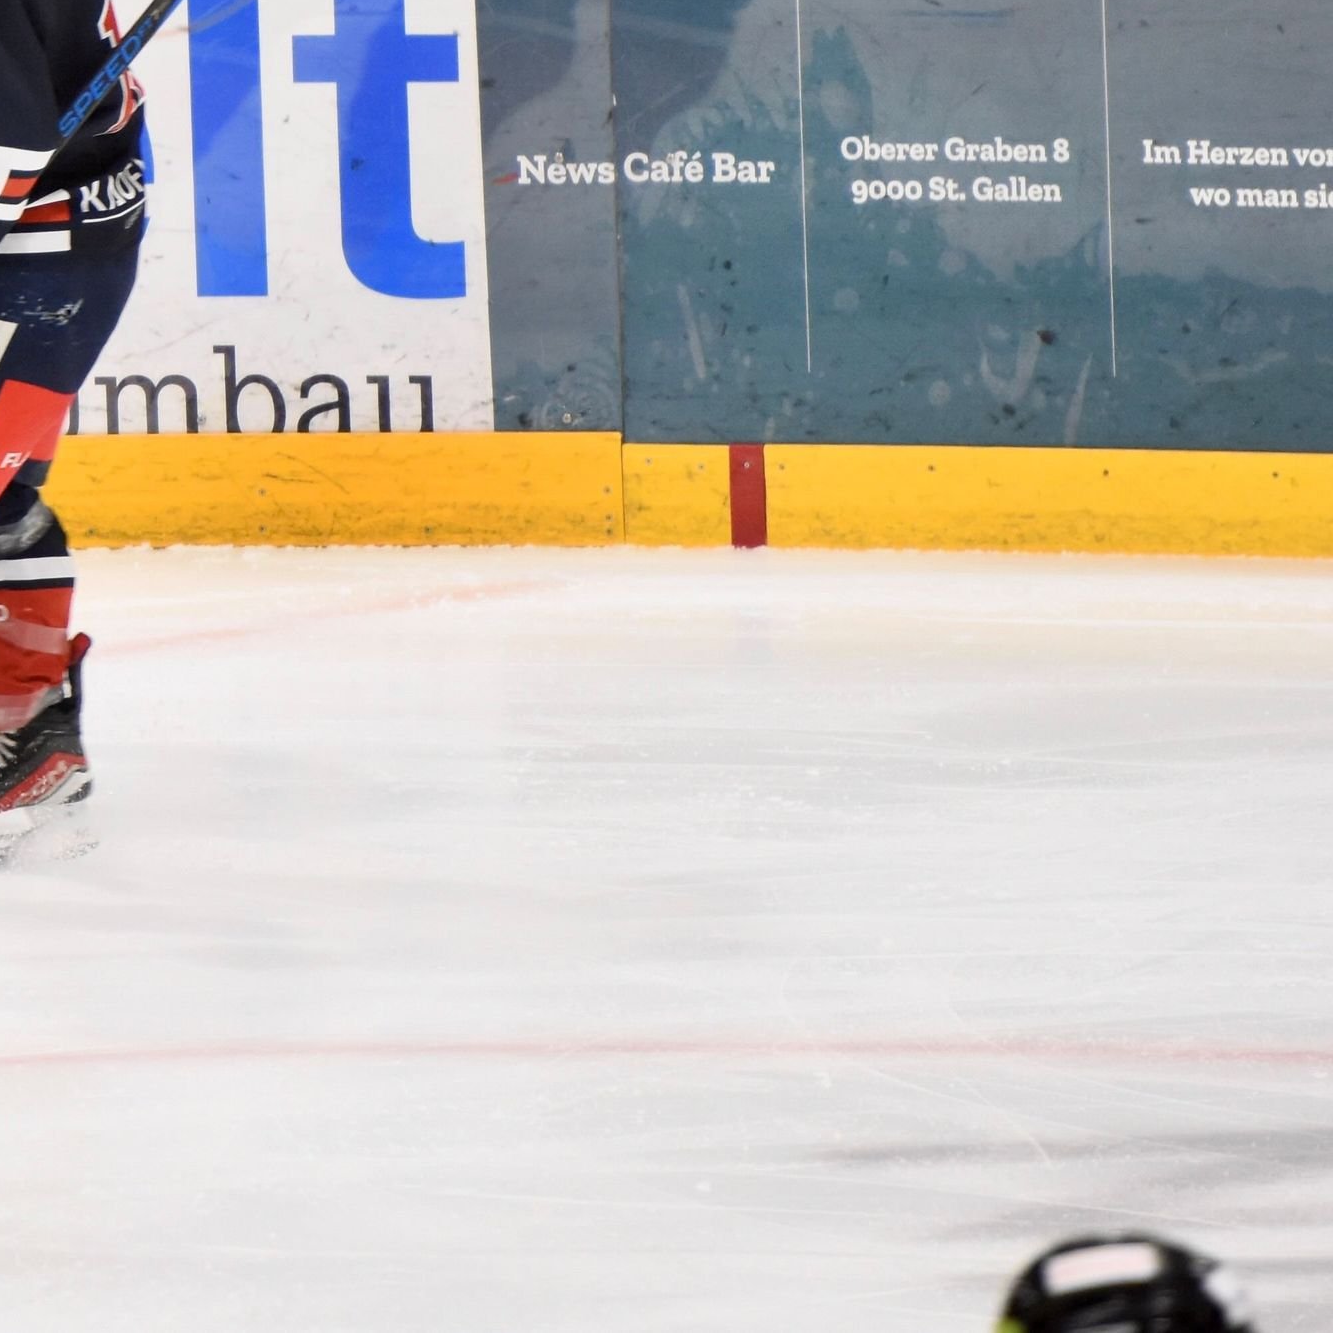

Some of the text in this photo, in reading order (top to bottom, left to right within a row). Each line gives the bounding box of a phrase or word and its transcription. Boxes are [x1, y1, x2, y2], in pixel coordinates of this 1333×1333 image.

[57, 33, 144, 138] SPEED
[840, 136, 1070, 163] Oberer Graben 8
[1142, 138, 1182, 165] Im
[1187, 139, 1289, 166] Herzen
[516, 151, 775, 186] News Café Bar
[851, 176, 1062, 205] 9000 St. Gallen
[1189, 186, 1231, 207] wo
[1236, 187, 1299, 208] man
